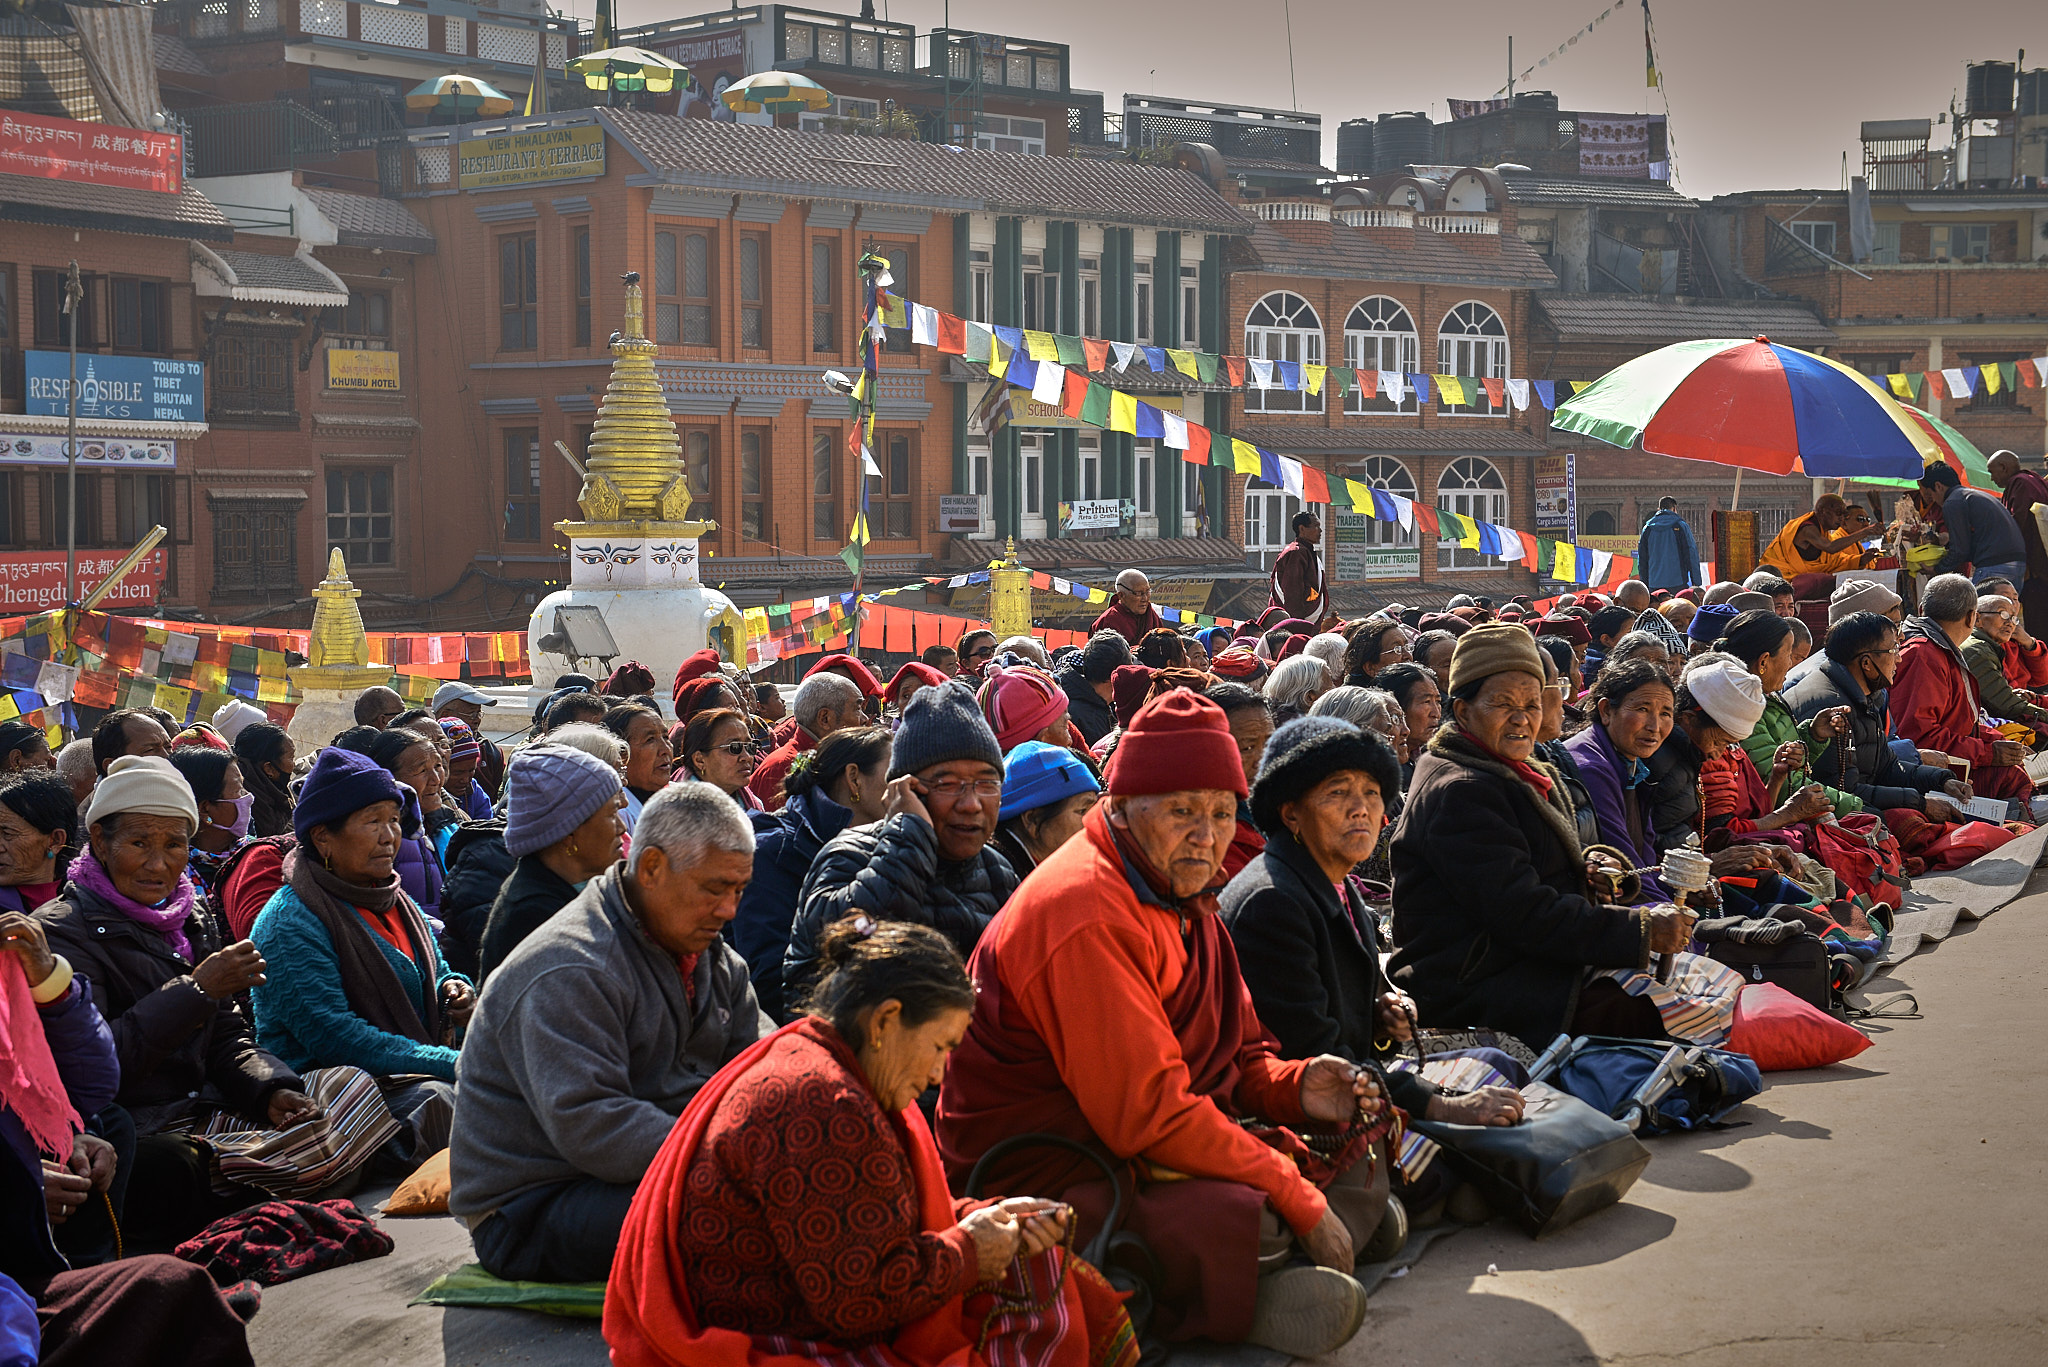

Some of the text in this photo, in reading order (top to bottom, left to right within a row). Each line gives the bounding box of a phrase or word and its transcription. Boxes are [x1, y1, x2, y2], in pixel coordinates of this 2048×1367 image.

[679, 40, 712, 62] RESTAURANT
[713, 40, 717, 59] &
[717, 35, 741, 57] TERRACE
[91, 134, 166, 157] 成都餐厅
[488, 130, 572, 151] VIEW HIMALAYAN
[460, 142, 603, 175] RESTAURANT & TERRACE
[153, 360, 200, 375] TOURS TO
[153, 376, 181, 390] TIBET
[332, 376, 397, 388] KHUMBU HOTEL
[153, 391, 192, 406] BHUTAN
[154, 407, 185, 421] NEPAL
[1028, 403, 1065, 418] SCHOOL
[1078, 502, 1118, 515] Prithivi
[1537, 502, 1556, 511] FedEx
[1336, 515, 1364, 526] TRADERS
[1536, 518, 1551, 527] Cargo
[1578, 539, 1606, 549] TOUCH
[1380, 555, 1391, 564] ART
[1393, 554, 1418, 563] TRADERS
[76, 558, 151, 575] 成都厅
[80, 580, 151, 600] Kchen
